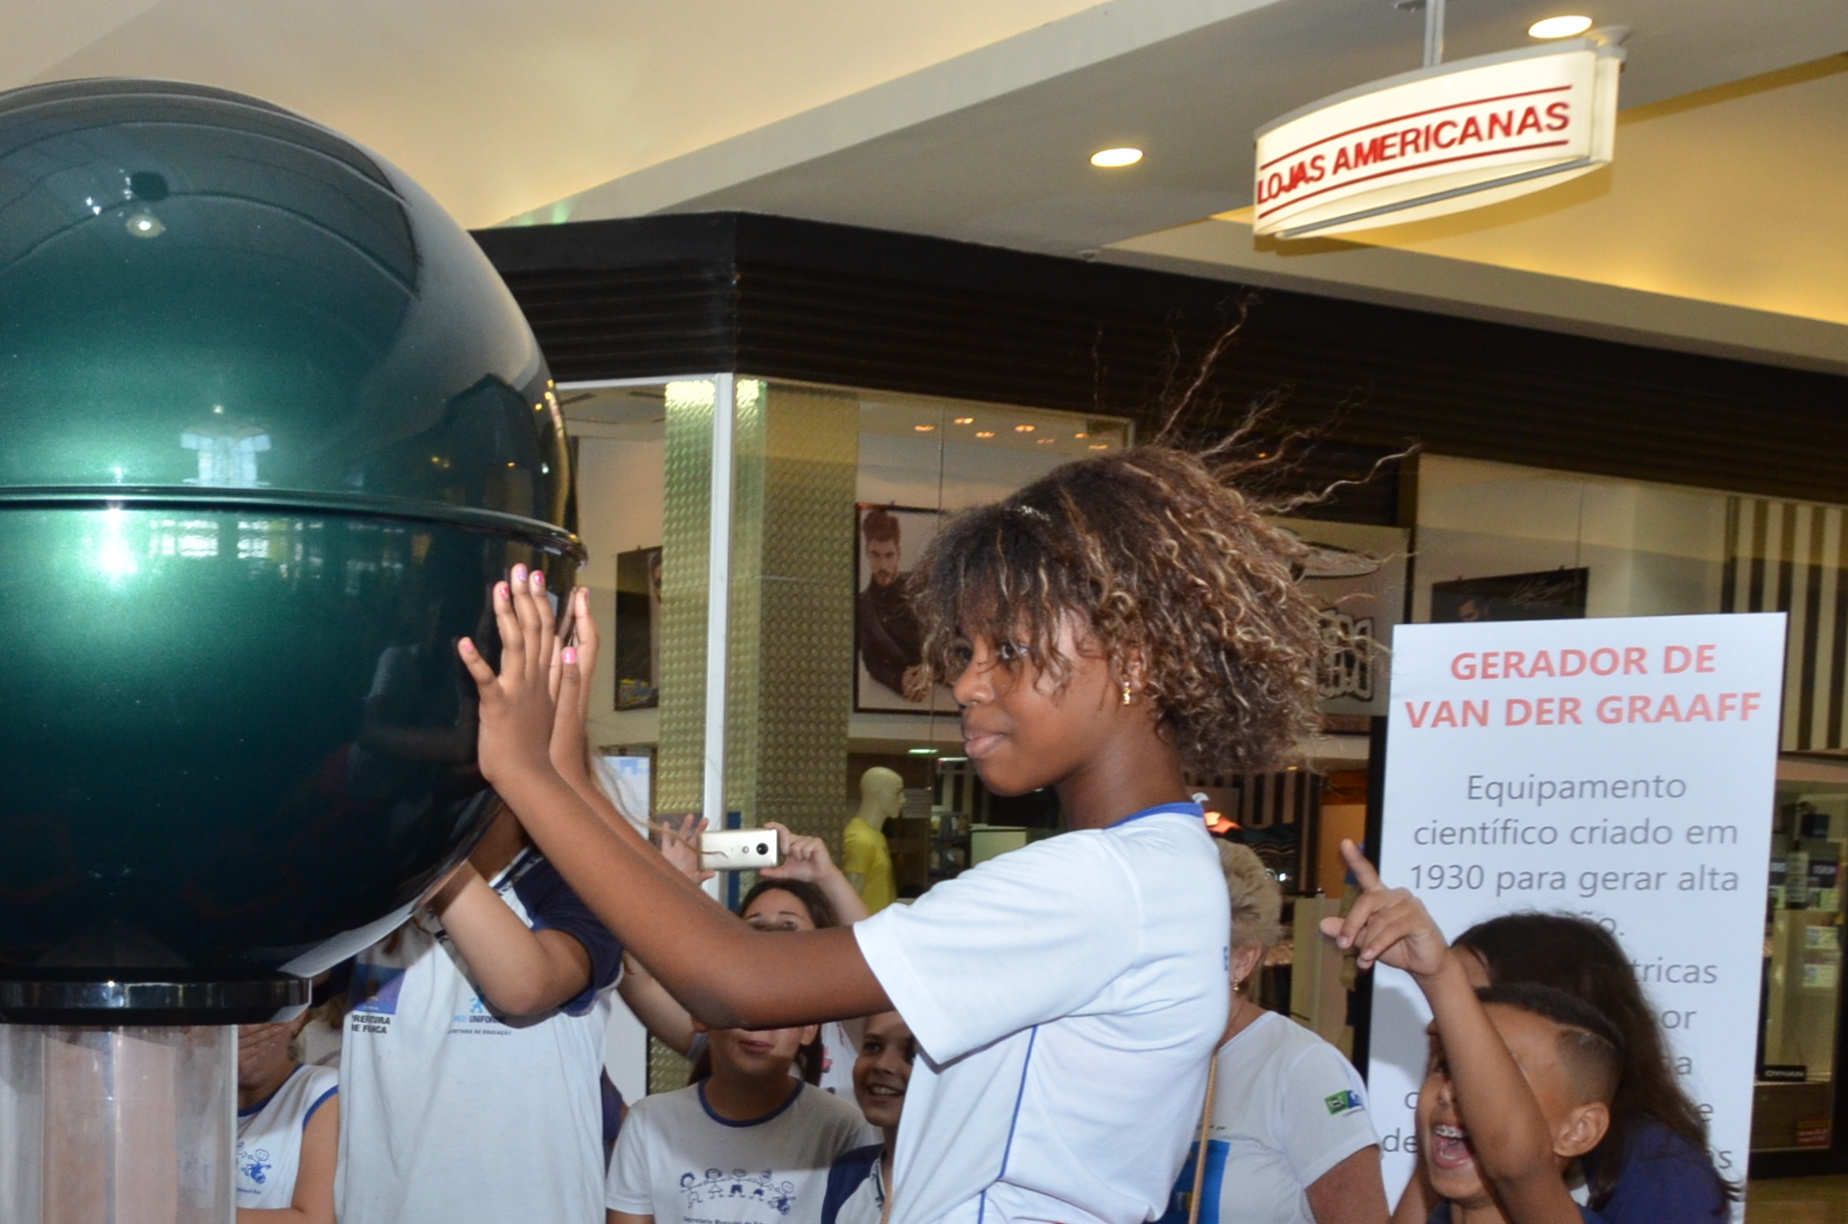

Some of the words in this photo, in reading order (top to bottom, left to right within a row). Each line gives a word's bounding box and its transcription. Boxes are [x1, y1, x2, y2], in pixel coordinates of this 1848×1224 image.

[1256, 154, 1326, 205] LOJAS
[1331, 101, 1571, 176] AMERICANAS
[1450, 646, 1649, 681] GERADOR
[1663, 644, 1717, 674] DE
[1405, 699, 1490, 728] VAN
[1504, 697, 1583, 727] DER
[1596, 692, 1762, 725] GRAAFF
[1467, 773, 1687, 807] Equipamento
[1413, 818, 1558, 846] científico
[1570, 818, 1673, 846] criado
[1685, 823, 1738, 846] em
[1409, 863, 1485, 892] 1930
[1496, 868, 1567, 897] para
[1578, 868, 1668, 898] gerar
[1677, 863, 1739, 892] alta
